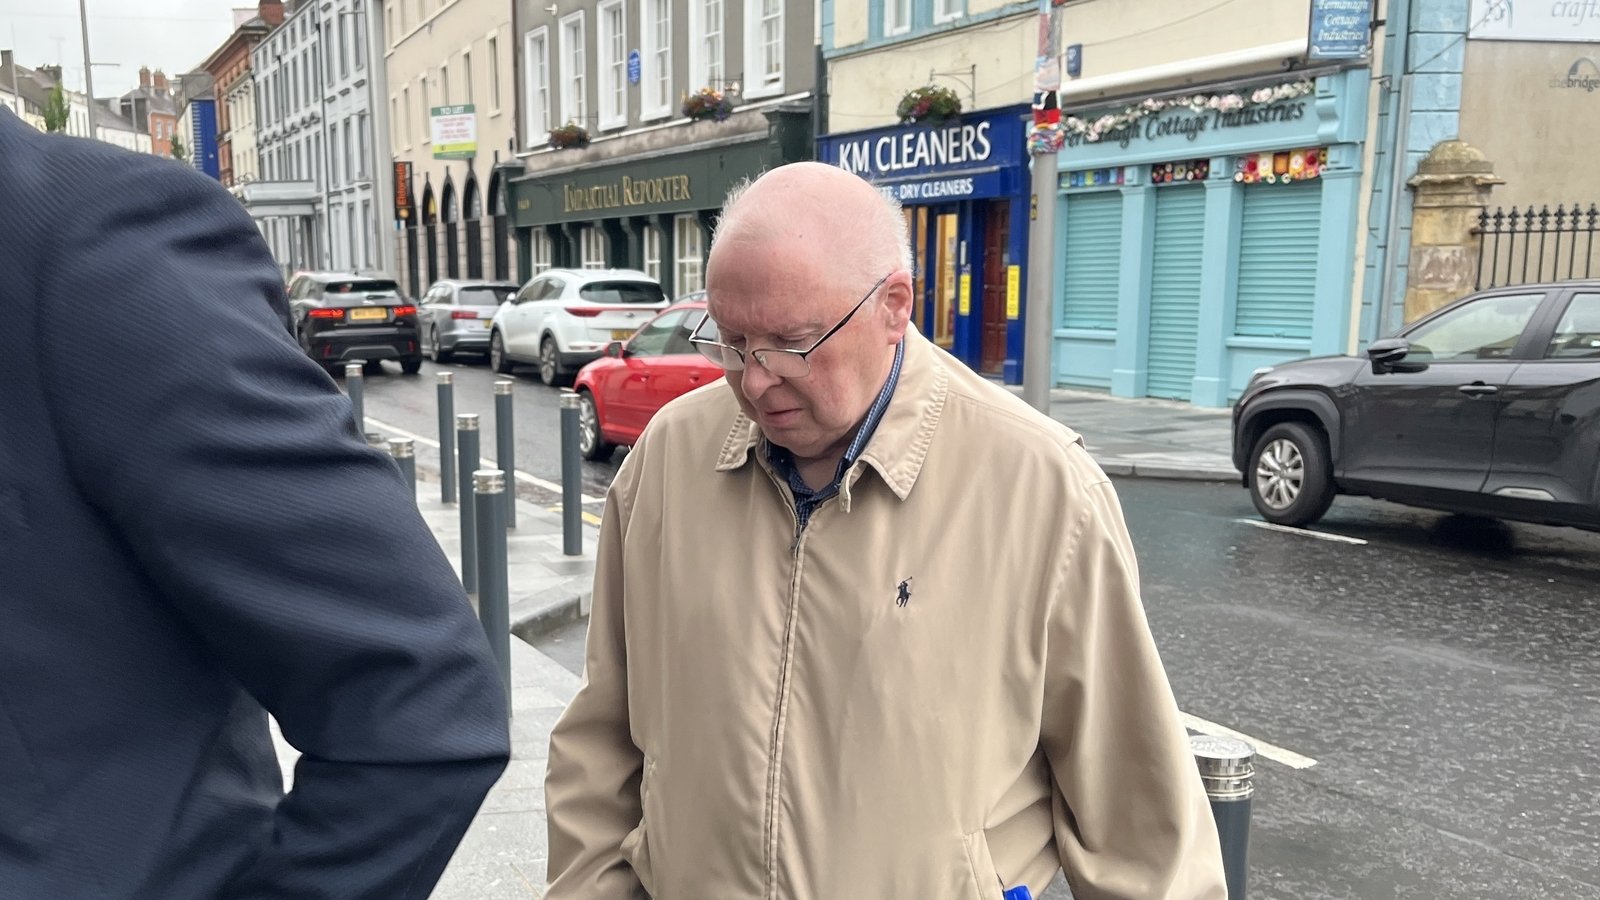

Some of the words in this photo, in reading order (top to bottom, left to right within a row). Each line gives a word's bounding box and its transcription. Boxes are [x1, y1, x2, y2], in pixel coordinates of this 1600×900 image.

[1318, 29, 1365, 42] Industries
[1324, 14, 1361, 29] Cottage
[1145, 113, 1208, 142] Cottage
[1212, 101, 1306, 130] Industries
[840, 140, 870, 175] KM
[876, 121, 991, 172] CLEANERS
[564, 184, 621, 212] IMPARTIAL
[622, 175, 691, 206] REPORTER
[900, 183, 920, 200] DRY
[922, 177, 974, 199] CLEANERS
